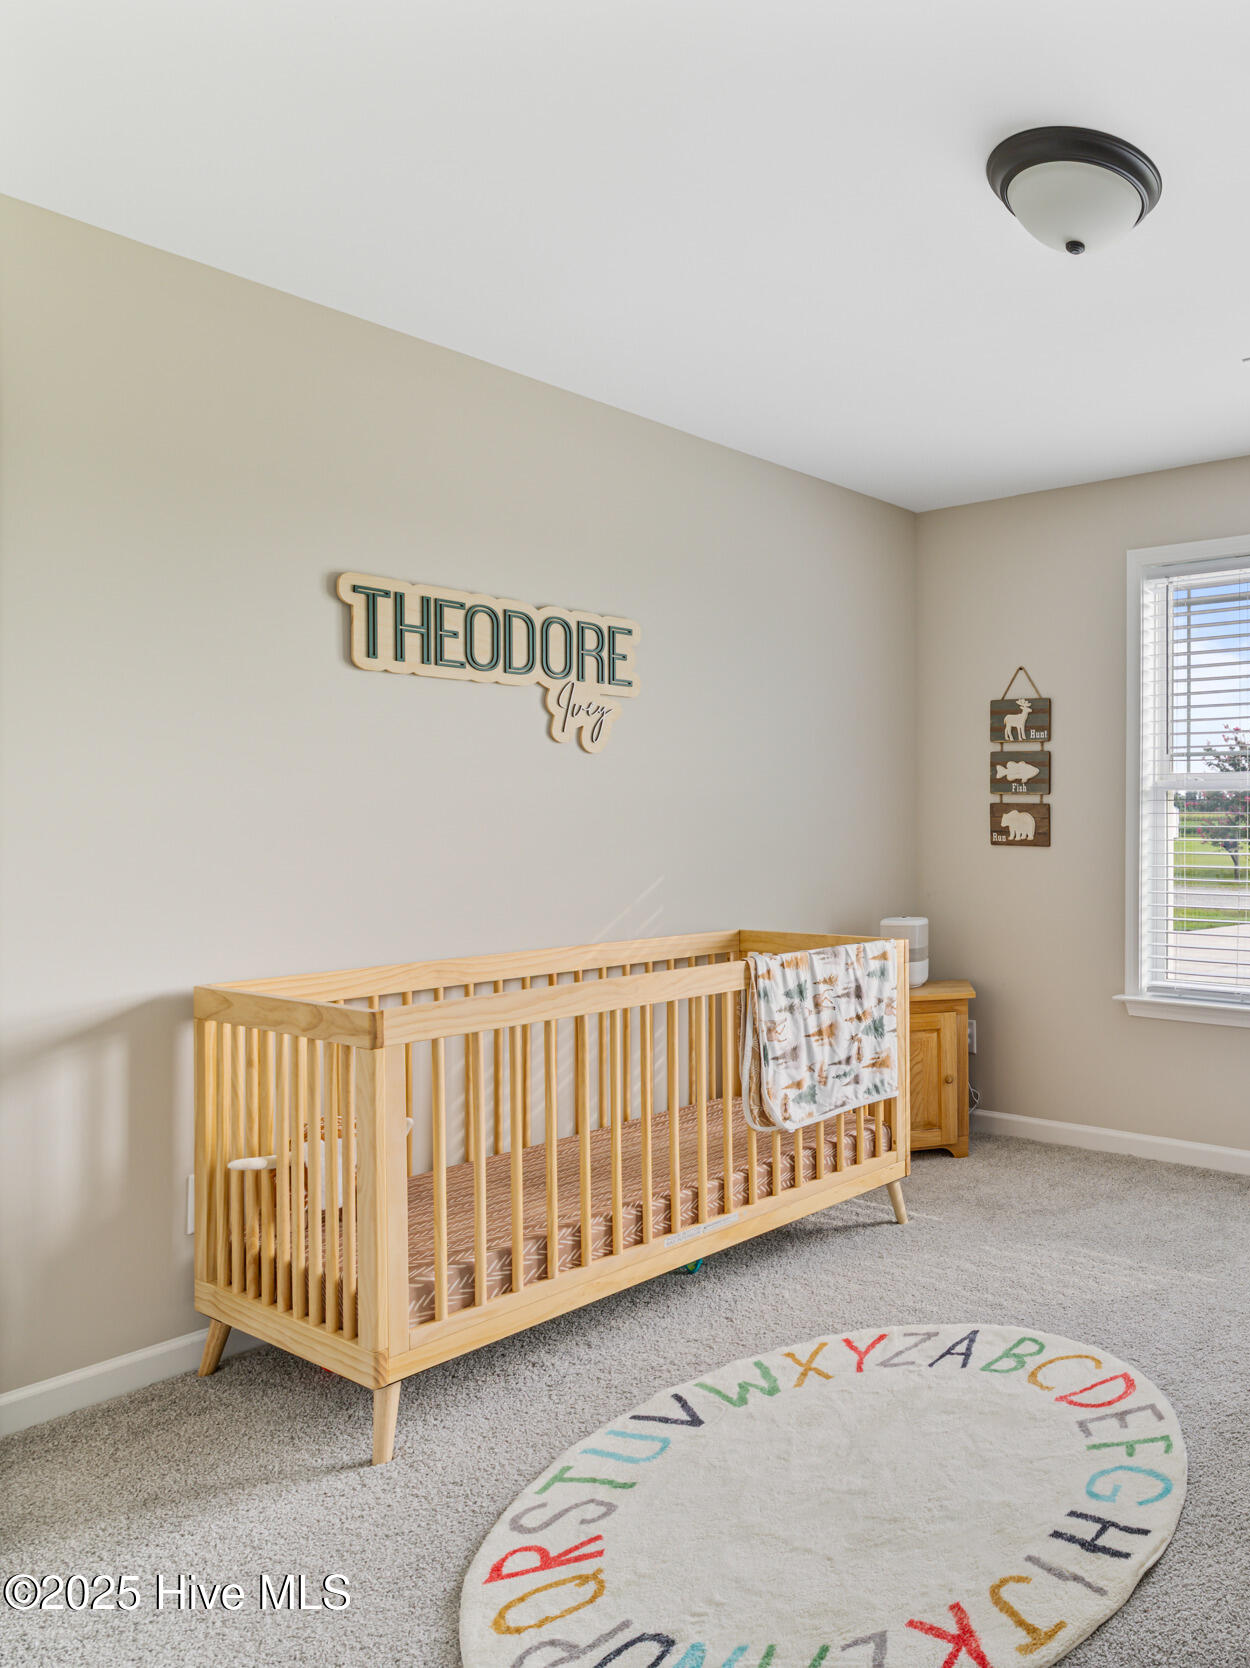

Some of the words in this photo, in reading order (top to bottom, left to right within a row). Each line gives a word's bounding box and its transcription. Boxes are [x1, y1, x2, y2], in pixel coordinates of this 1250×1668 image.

[352, 584, 633, 687] THEODORE
[1030, 729, 1048, 739] Hunt
[1012, 783, 1027, 792] Fish
[992, 832, 1007, 842] Run
